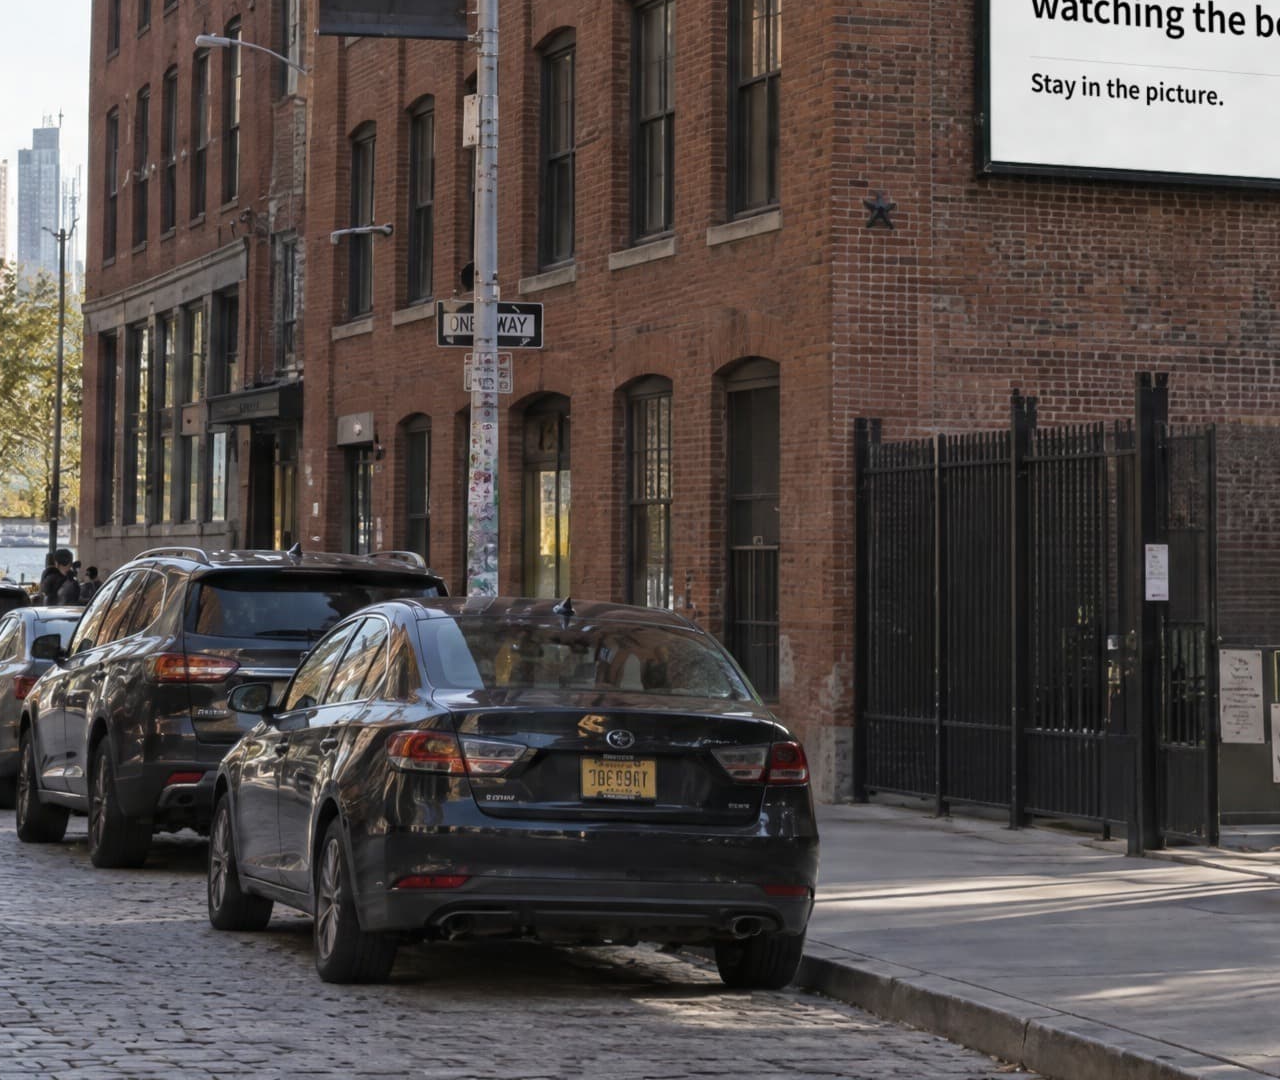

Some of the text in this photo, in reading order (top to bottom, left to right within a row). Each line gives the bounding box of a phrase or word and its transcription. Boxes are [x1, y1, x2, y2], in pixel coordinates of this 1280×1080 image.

[1192, 0, 1246, 36] the
[1031, 72, 1224, 107] Stay in the picture.
[497, 316, 528, 333] WAY
